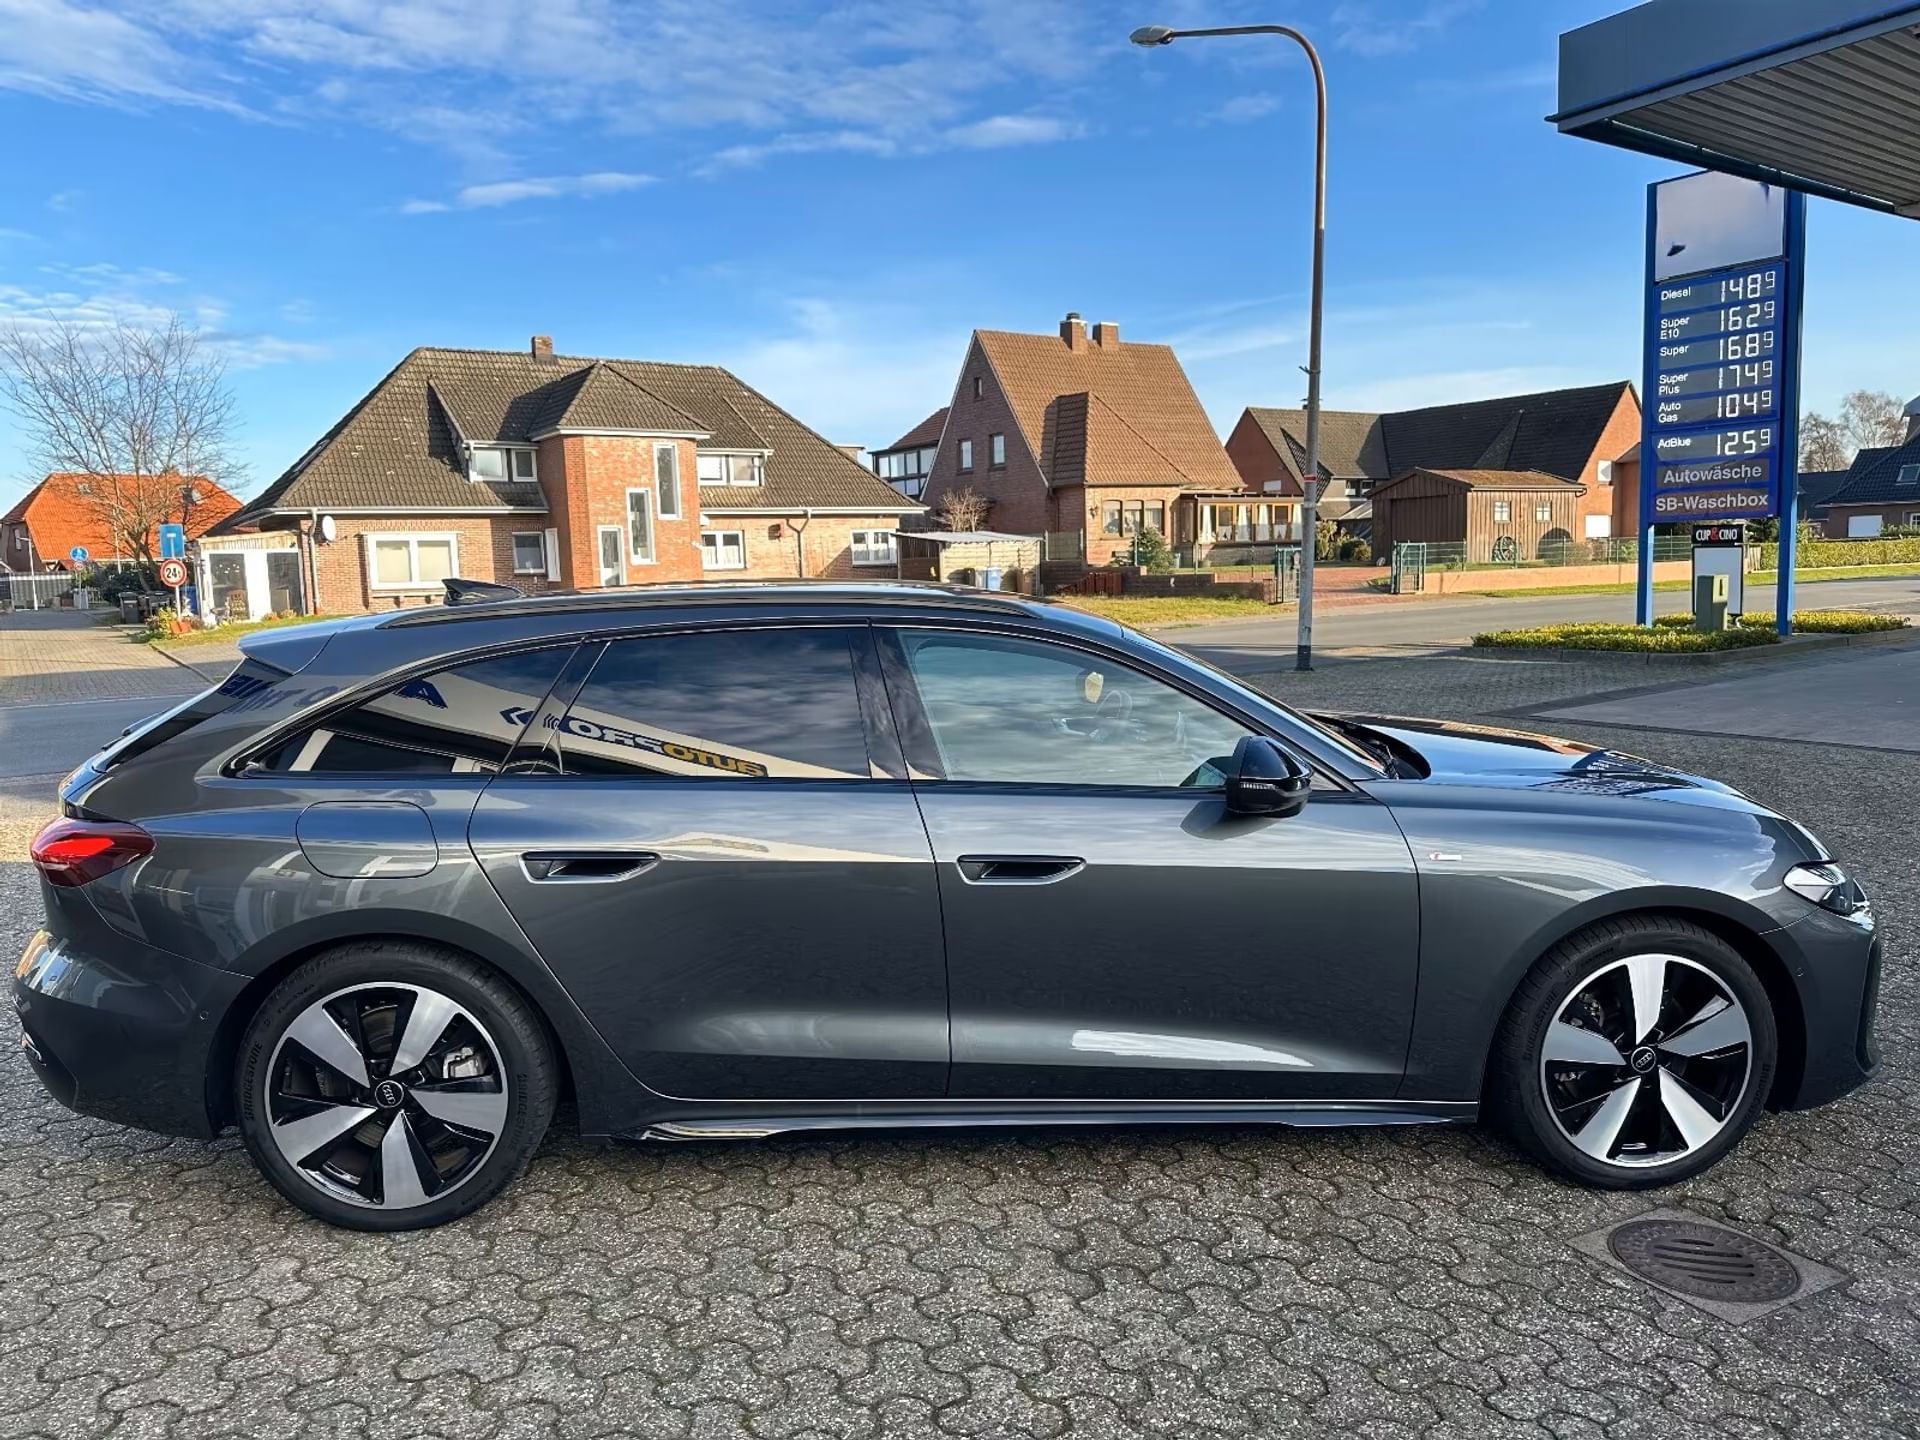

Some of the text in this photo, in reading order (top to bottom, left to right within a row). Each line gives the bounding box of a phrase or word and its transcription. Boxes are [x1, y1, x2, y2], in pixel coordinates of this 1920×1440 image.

[1660, 287, 1691, 301] Diesel
[1660, 317, 1690, 330] Super
[1660, 329, 1679, 340] E10
[1659, 345, 1690, 357] Super
[1659, 373, 1688, 386] Super
[1658, 385, 1680, 396] Plus
[1658, 402, 1681, 412] Auto
[1658, 413, 1678, 423] Gas
[1657, 436, 1692, 449] AdBlue
[1663, 464, 1762, 484] Autowäsche
[1656, 493, 1769, 512] SB-Waschbox
[245, 1040, 263, 1122] BRIDGESTONE
